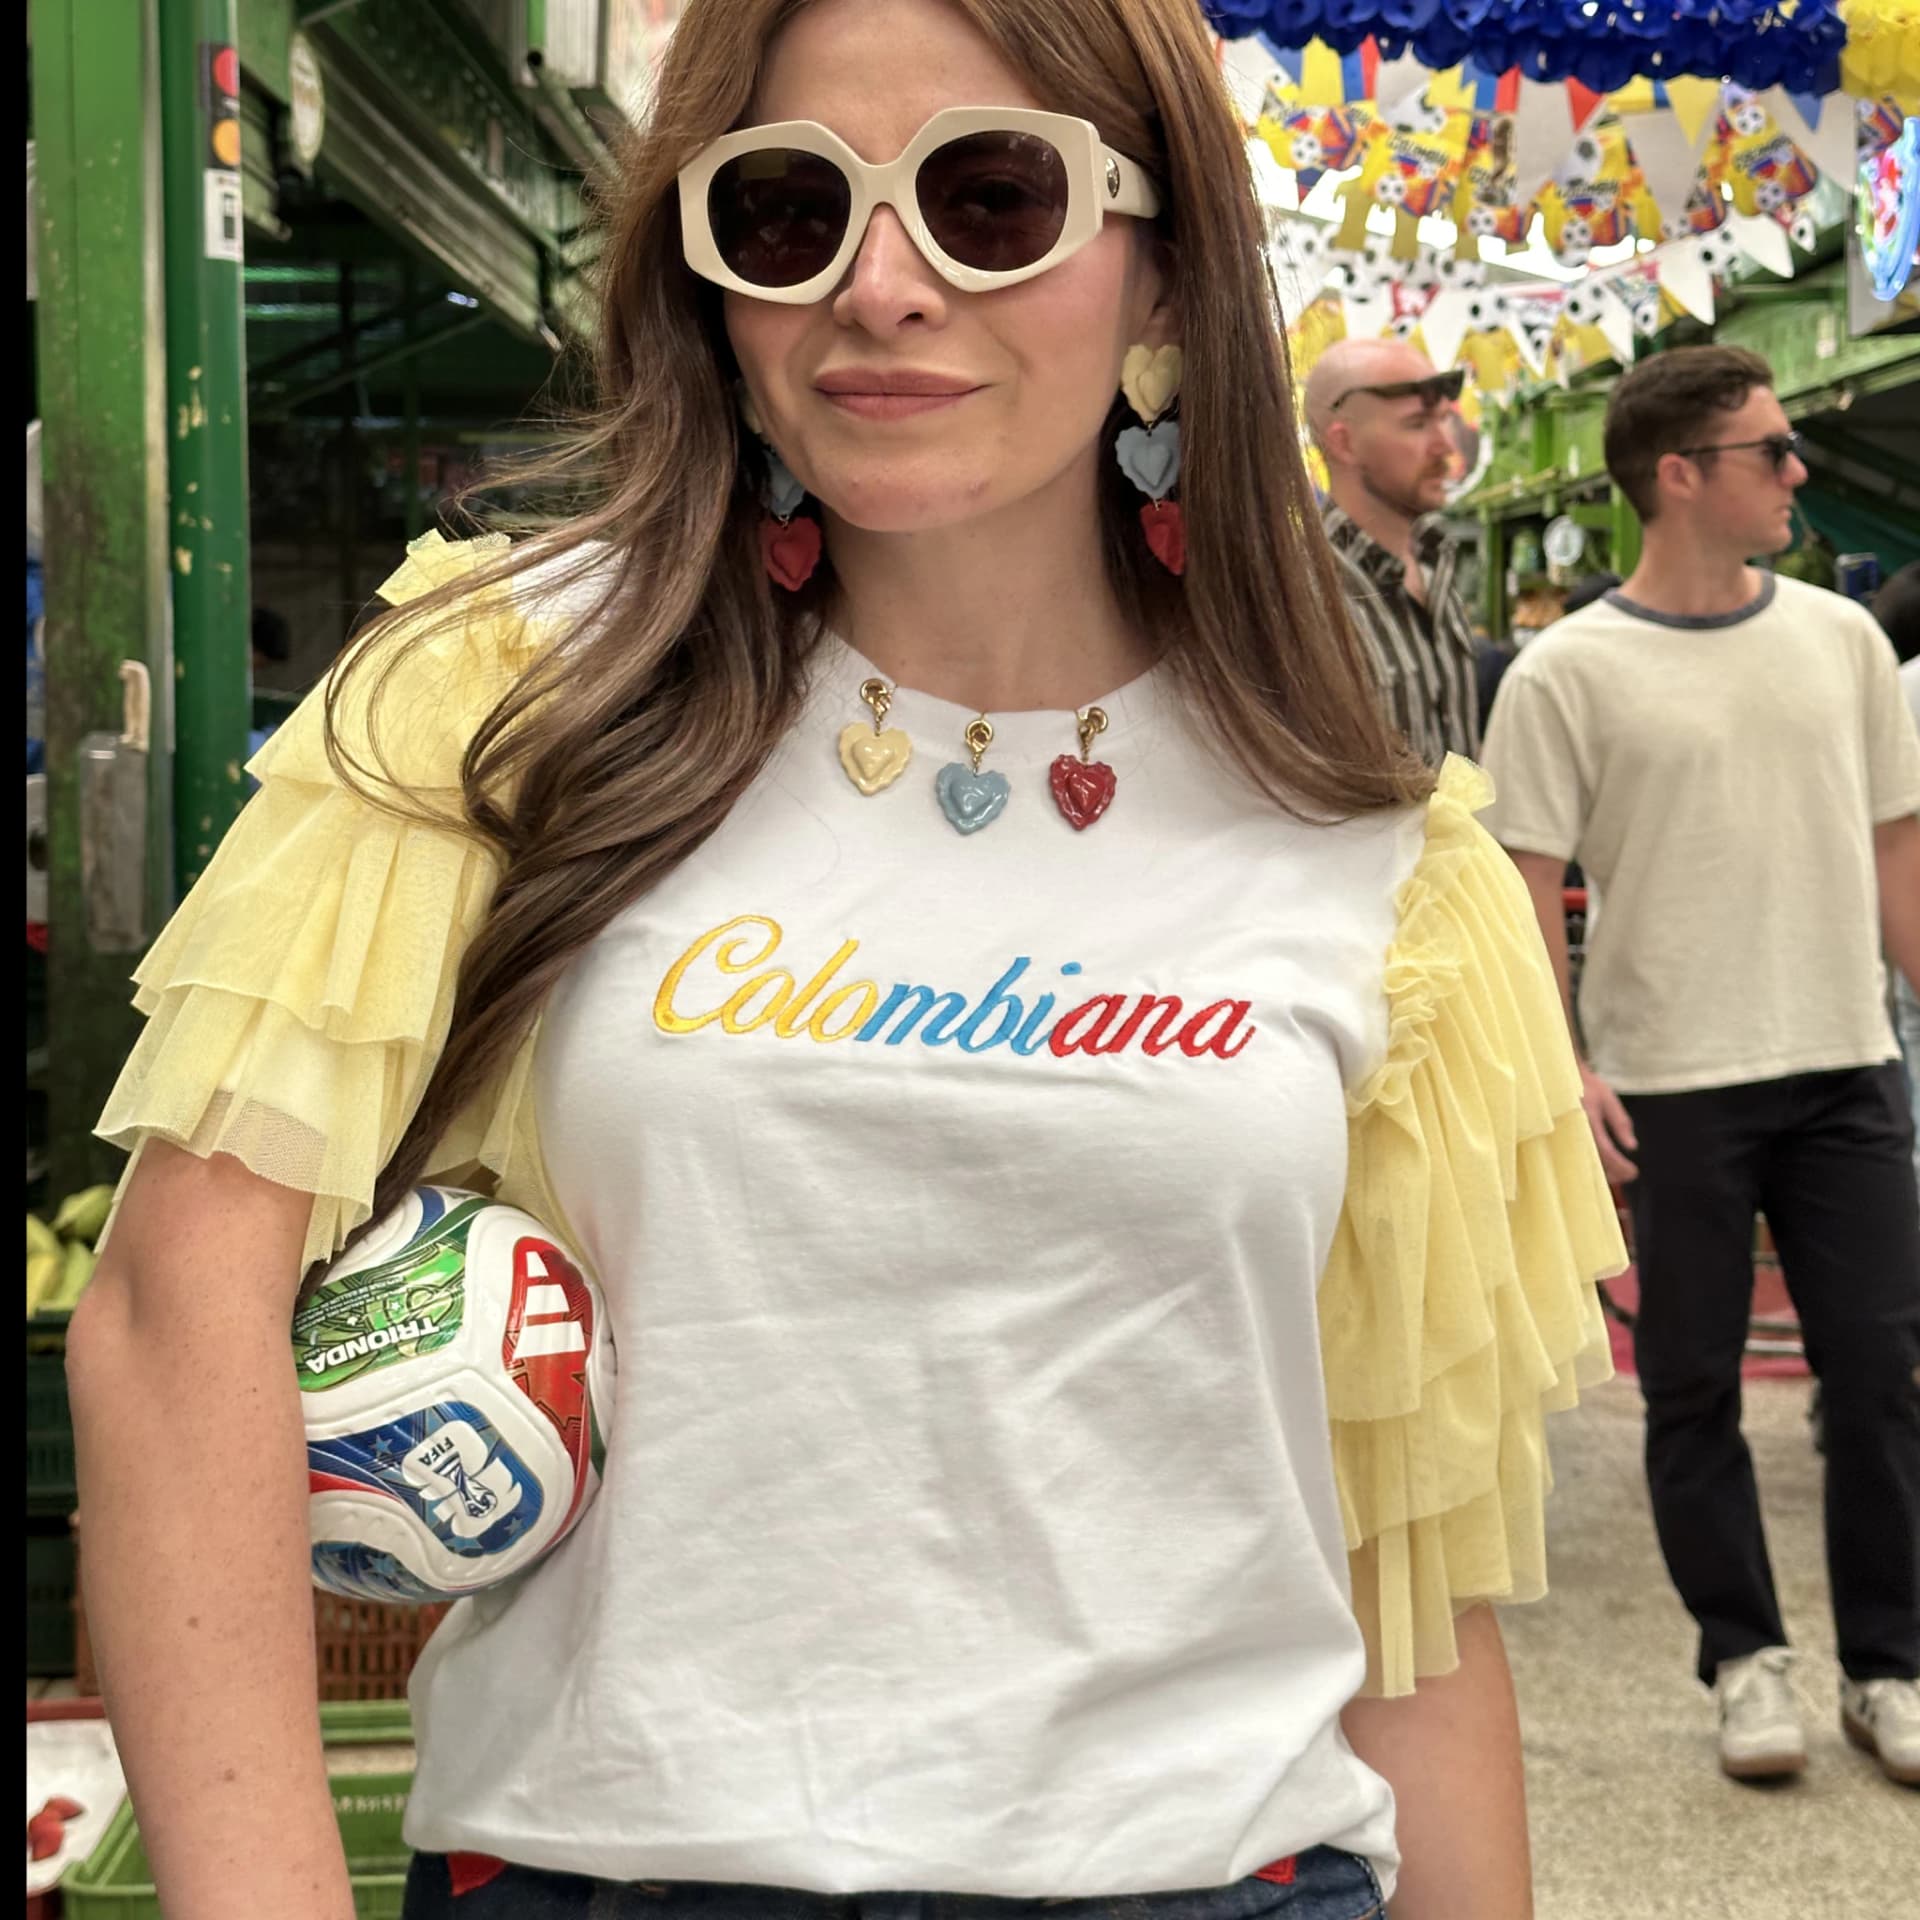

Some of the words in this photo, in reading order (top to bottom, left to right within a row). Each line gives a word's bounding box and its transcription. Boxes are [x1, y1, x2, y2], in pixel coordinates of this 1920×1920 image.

[654, 915, 1255, 1060] Colombiana
[305, 1317, 440, 1375] TRIONDA
[418, 1437, 454, 1466] FIFA
